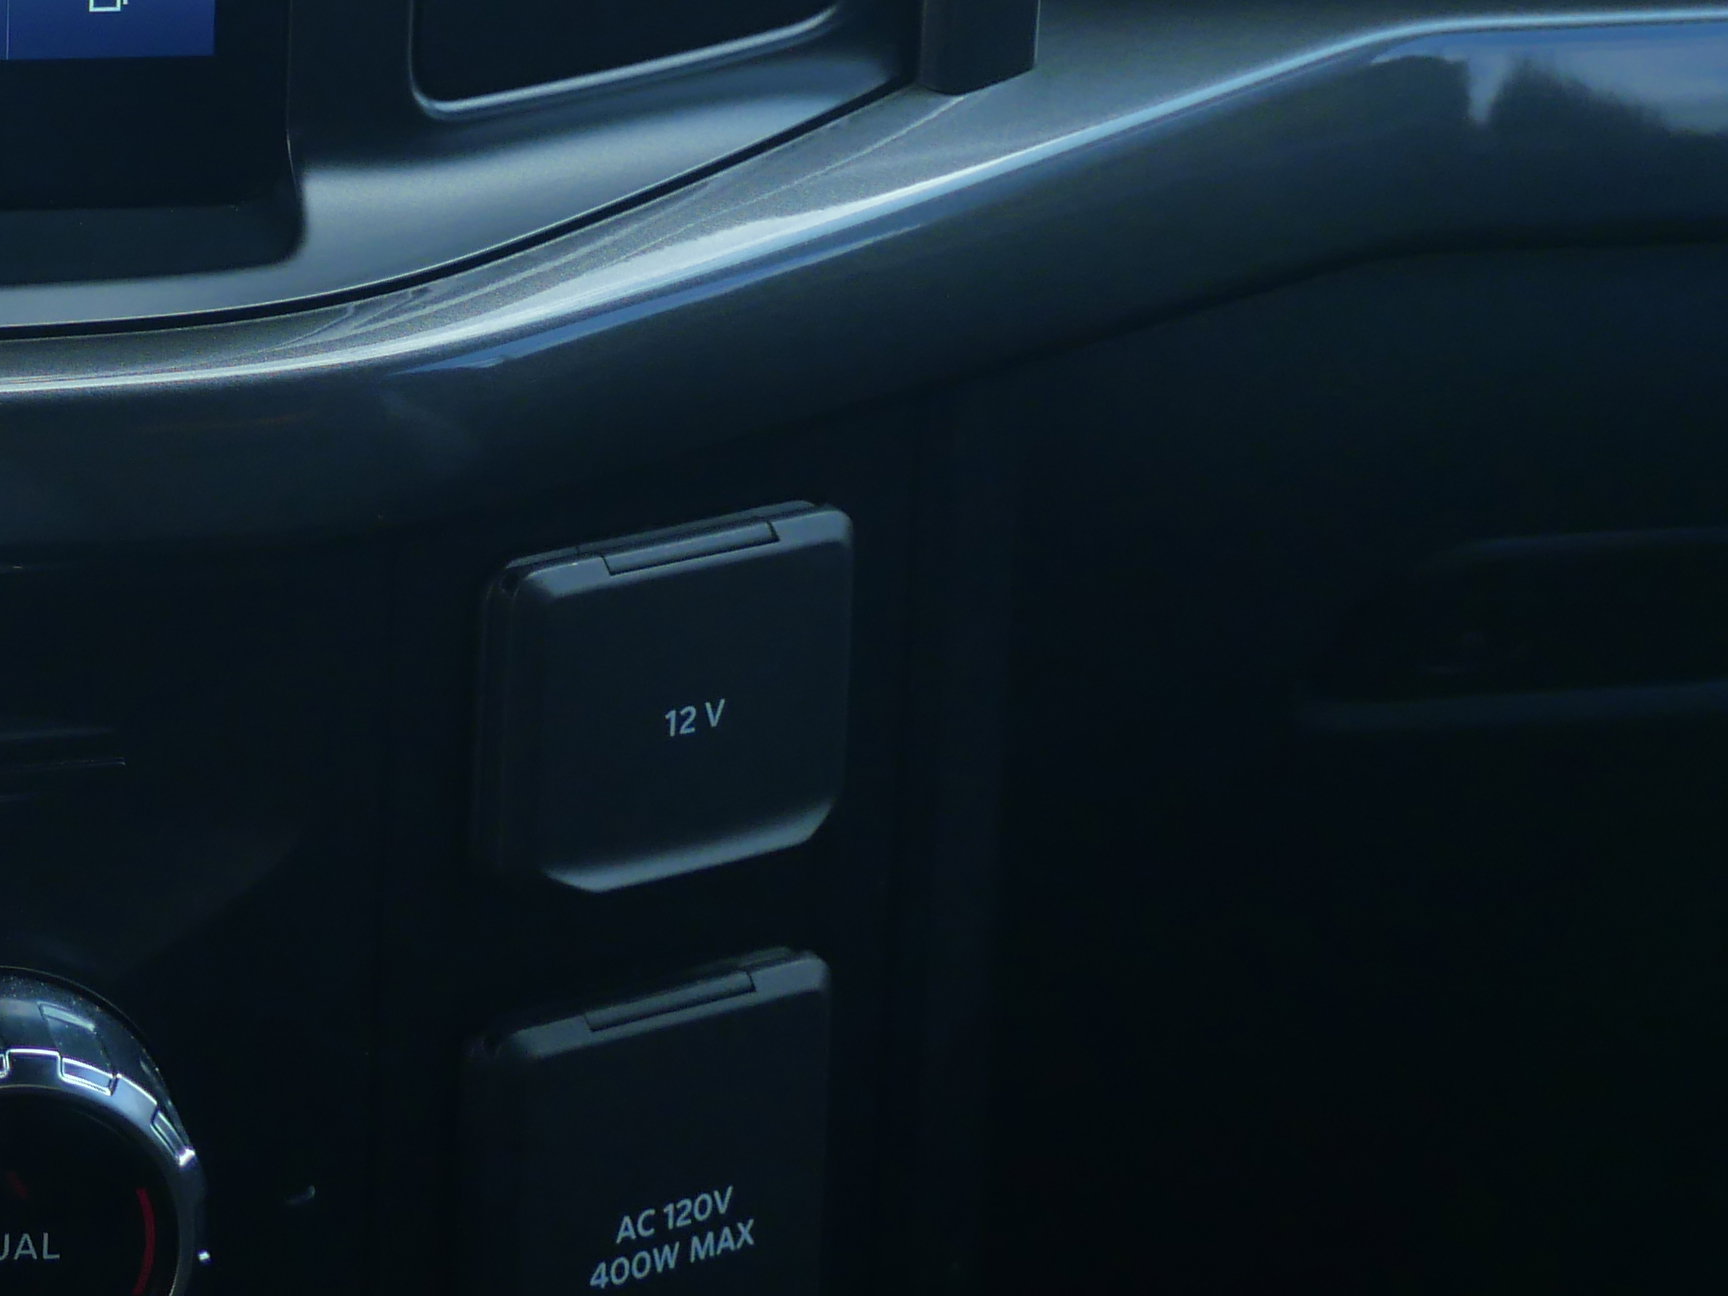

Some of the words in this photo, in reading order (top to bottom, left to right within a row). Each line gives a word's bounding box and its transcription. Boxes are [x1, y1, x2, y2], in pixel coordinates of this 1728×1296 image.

[664, 705, 697, 737] 12
[704, 698, 726, 728] V
[615, 1207, 656, 1245] AC
[663, 1184, 734, 1230] 120V
[589, 1240, 681, 1290] 400W
[689, 1217, 755, 1264] MAX
